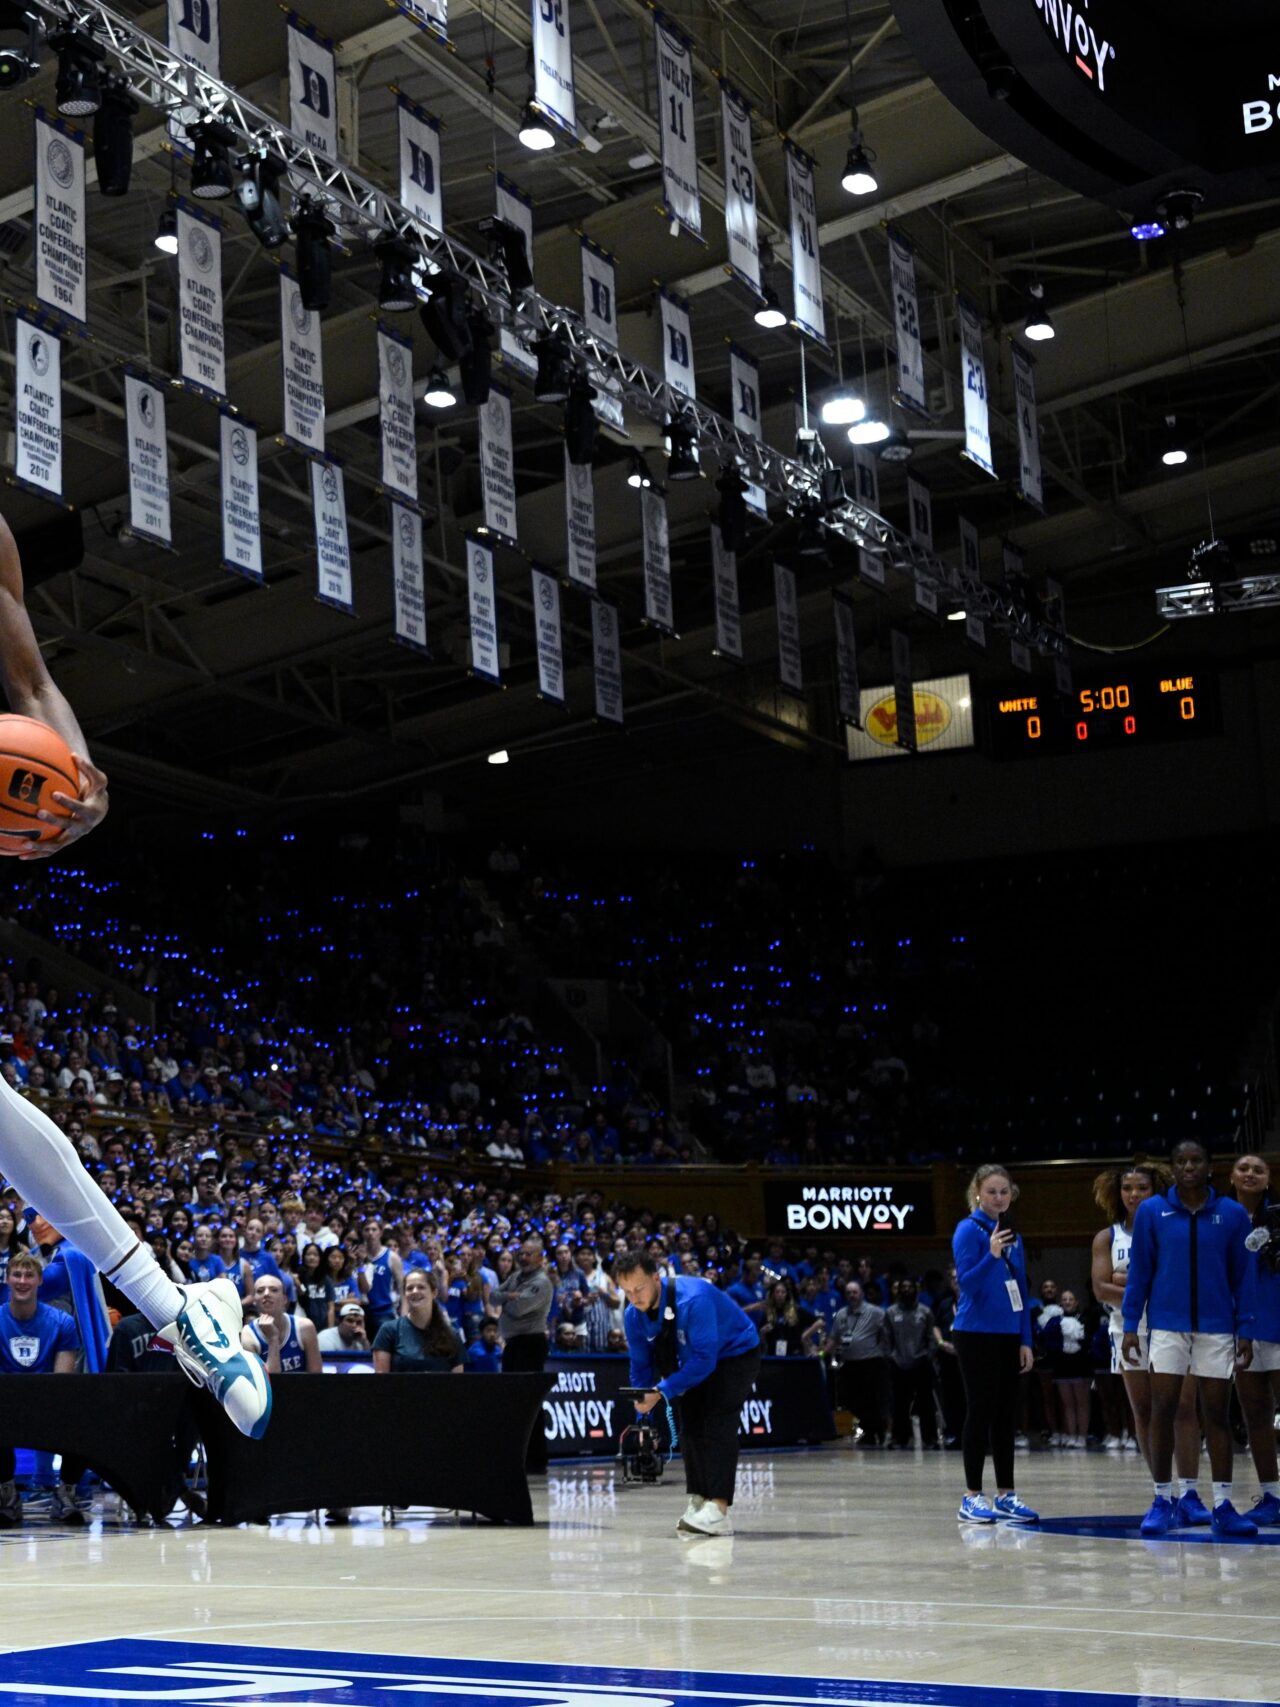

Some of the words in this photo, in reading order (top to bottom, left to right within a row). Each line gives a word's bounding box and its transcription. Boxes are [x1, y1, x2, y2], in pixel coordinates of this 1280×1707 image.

[46, 195, 77, 222] ATLANTIC
[50, 213, 73, 235] COAST
[39, 223, 85, 260] CONFERENCE
[41, 241, 83, 276] CHAMPIONS
[53, 284, 74, 305] 1964
[187, 278, 216, 304] ATLANTIC
[193, 296, 212, 317] COAST
[182, 306, 223, 339] CONFERENCE
[185, 323, 223, 353] CHAMPIONS
[290, 340, 317, 365] ATLANTIC
[294, 357, 312, 376] COAST
[285, 367, 324, 397] CONFERENCE
[24, 383, 55, 408] ATLANTIC
[287, 383, 322, 411] CHAMPIONS
[29, 400, 49, 421] COAST
[19, 410, 61, 441] CONFERENCE
[20, 426, 59, 454] CHAMPIONS
[135, 437, 162, 459] ATLANTIC
[30, 463, 49, 481] 2010
[139, 453, 157, 470] COAST
[131, 463, 169, 490] CONFERENCE
[230, 475, 254, 495] ATLANTIC
[133, 478, 169, 502] CHAMPIONS
[233, 490, 250, 507] COAST
[145, 512, 161, 529] 2011
[225, 499, 259, 523] CONFERENCE
[228, 513, 260, 537] CHAMPIONS
[1160, 677, 1194, 692] BLUE
[999, 697, 1038, 713] WHITE
[1080, 685, 1130, 712] 5:00
[1181, 697, 1195, 720] 0
[1027, 716, 1041, 738] 0
[1076, 721, 1088, 740] 0
[1124, 716, 1136, 734] 0
[802, 1187, 893, 1201] MARRIOTT
[786, 1204, 909, 1230] BONVOY
